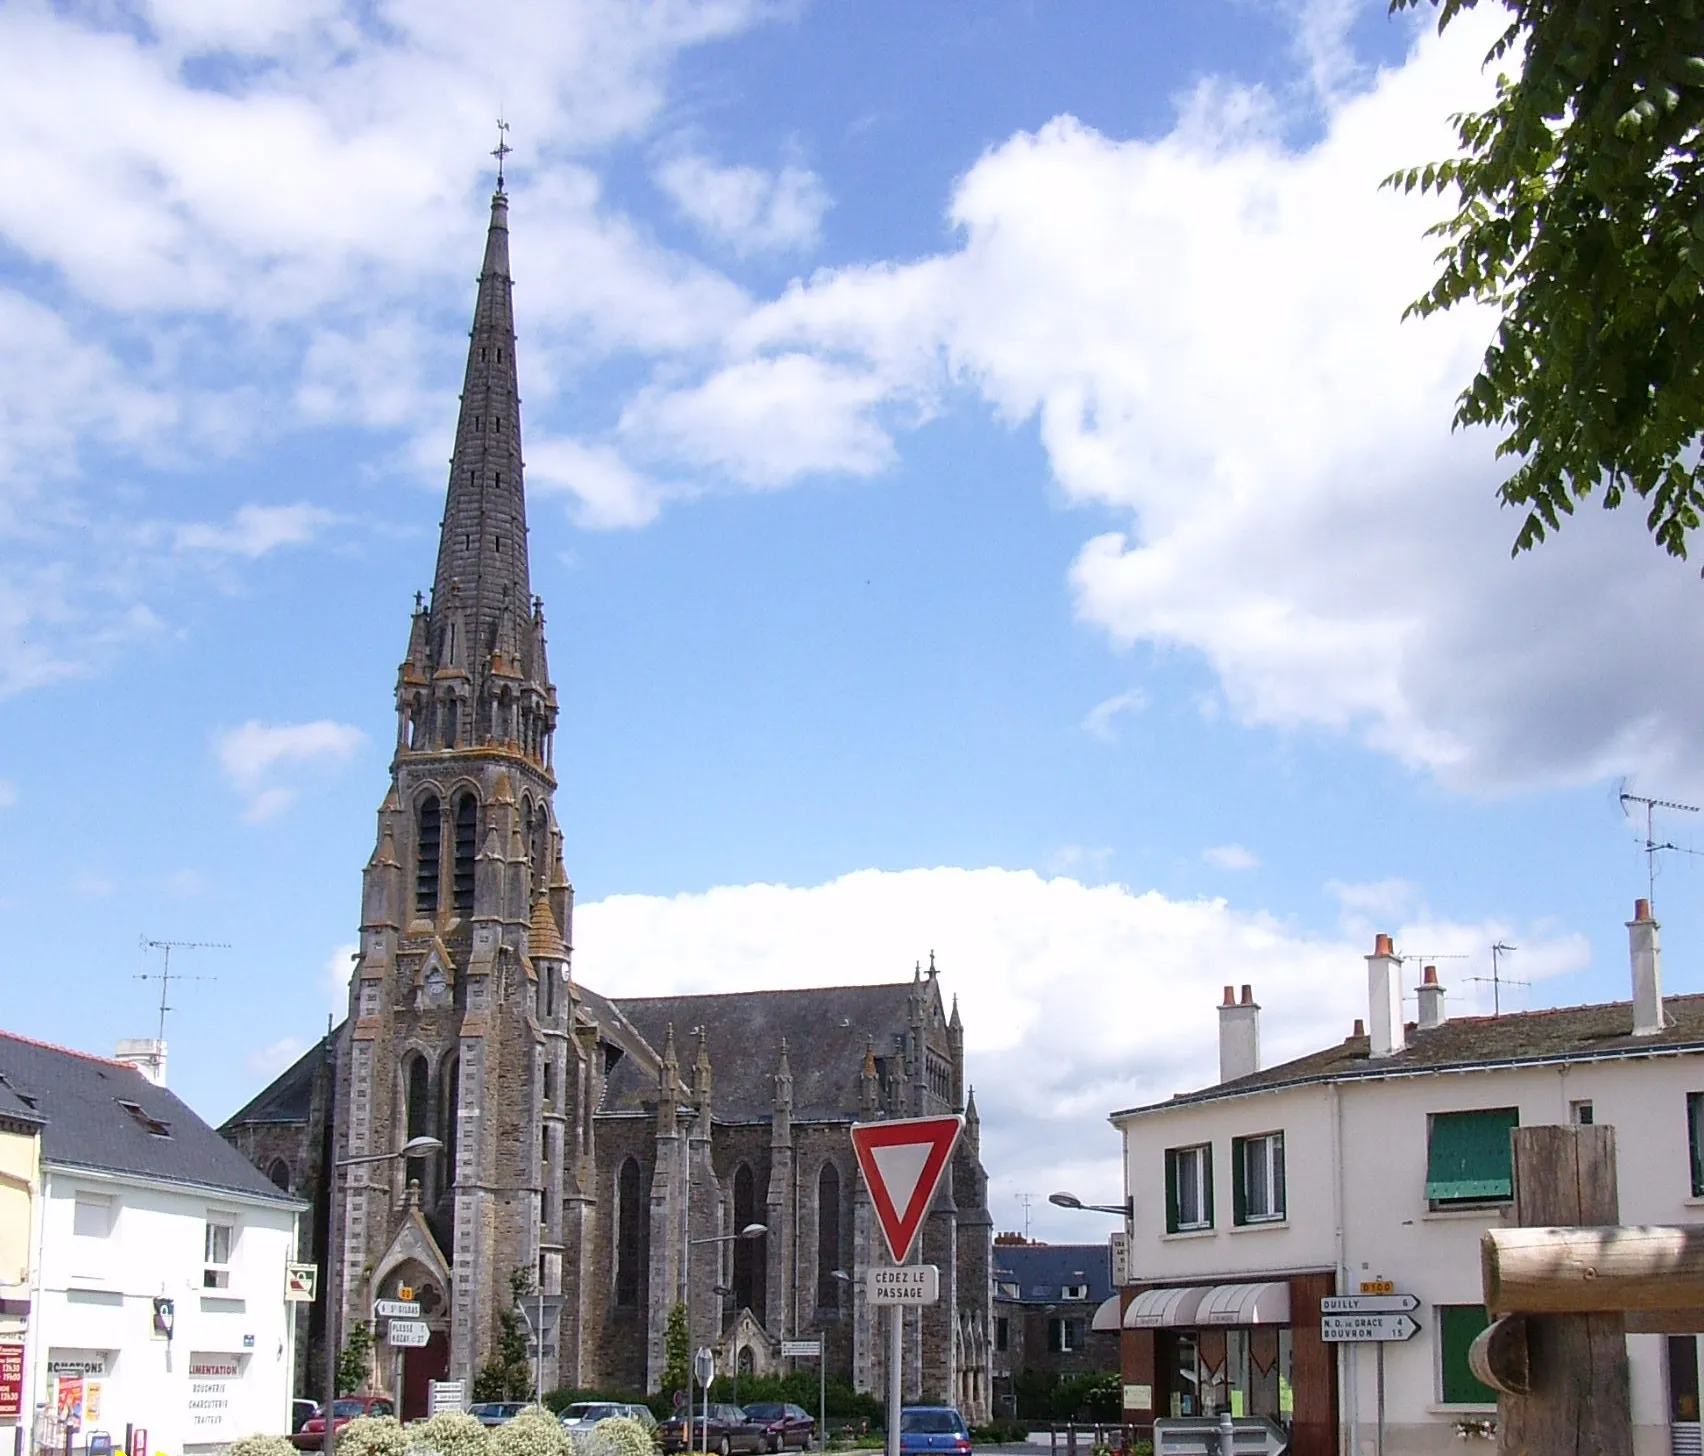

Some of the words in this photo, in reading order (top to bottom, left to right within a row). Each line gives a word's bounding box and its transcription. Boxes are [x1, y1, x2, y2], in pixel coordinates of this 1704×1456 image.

[876, 1271, 908, 1283] CÉDEZ
[913, 1272, 925, 1282] LE
[877, 1288, 922, 1298] PASSAGE
[1324, 1330, 1372, 1338] BOUVRON
[189, 1365, 238, 1375] LIMENTATION
